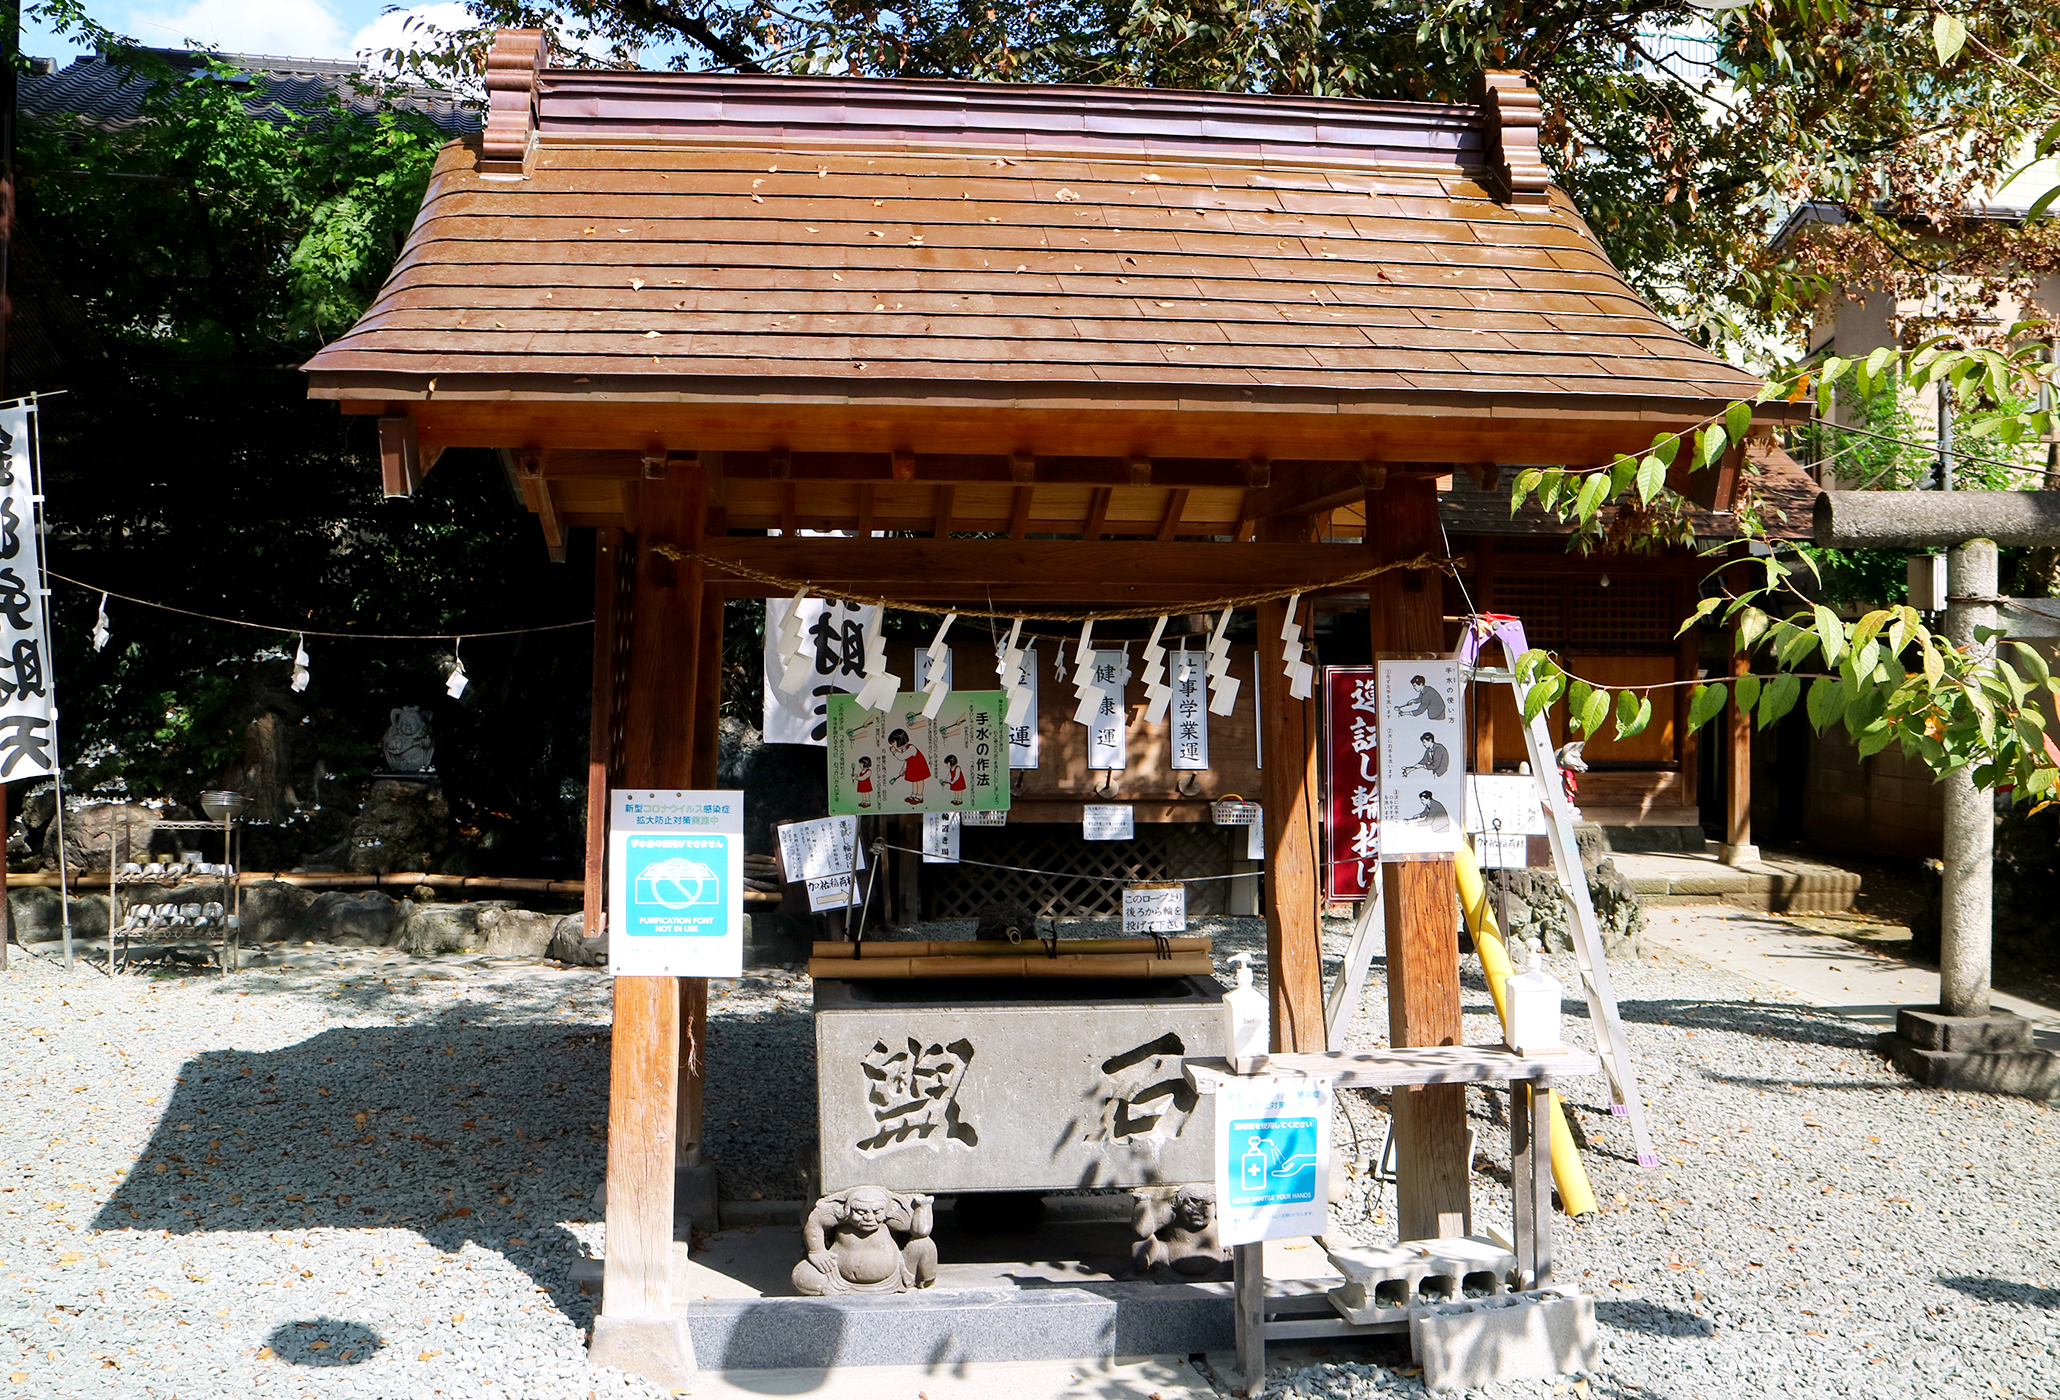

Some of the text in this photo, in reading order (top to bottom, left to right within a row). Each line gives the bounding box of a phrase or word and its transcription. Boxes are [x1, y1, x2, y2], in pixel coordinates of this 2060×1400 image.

[1095, 664, 1117, 748] 健康運
[976, 712, 990, 787] 手水の作法
[625, 804, 731, 814] 新型コロナウイルス感染症
[636, 816, 719, 825] 拡大防止対策実施中
[1125, 893, 1182, 904] このロープより
[1126, 906, 1182, 918] 後ろから輪を
[639, 917, 714, 925] PURIFICATION FONT
[1125, 920, 1184, 931] 投げて下さい
[655, 925, 699, 933] NOT IN USE
[1232, 1196, 1251, 1205] PLEASE
[1252, 1194, 1275, 1203] SANITISE
[1276, 1193, 1292, 1201] YOUR
